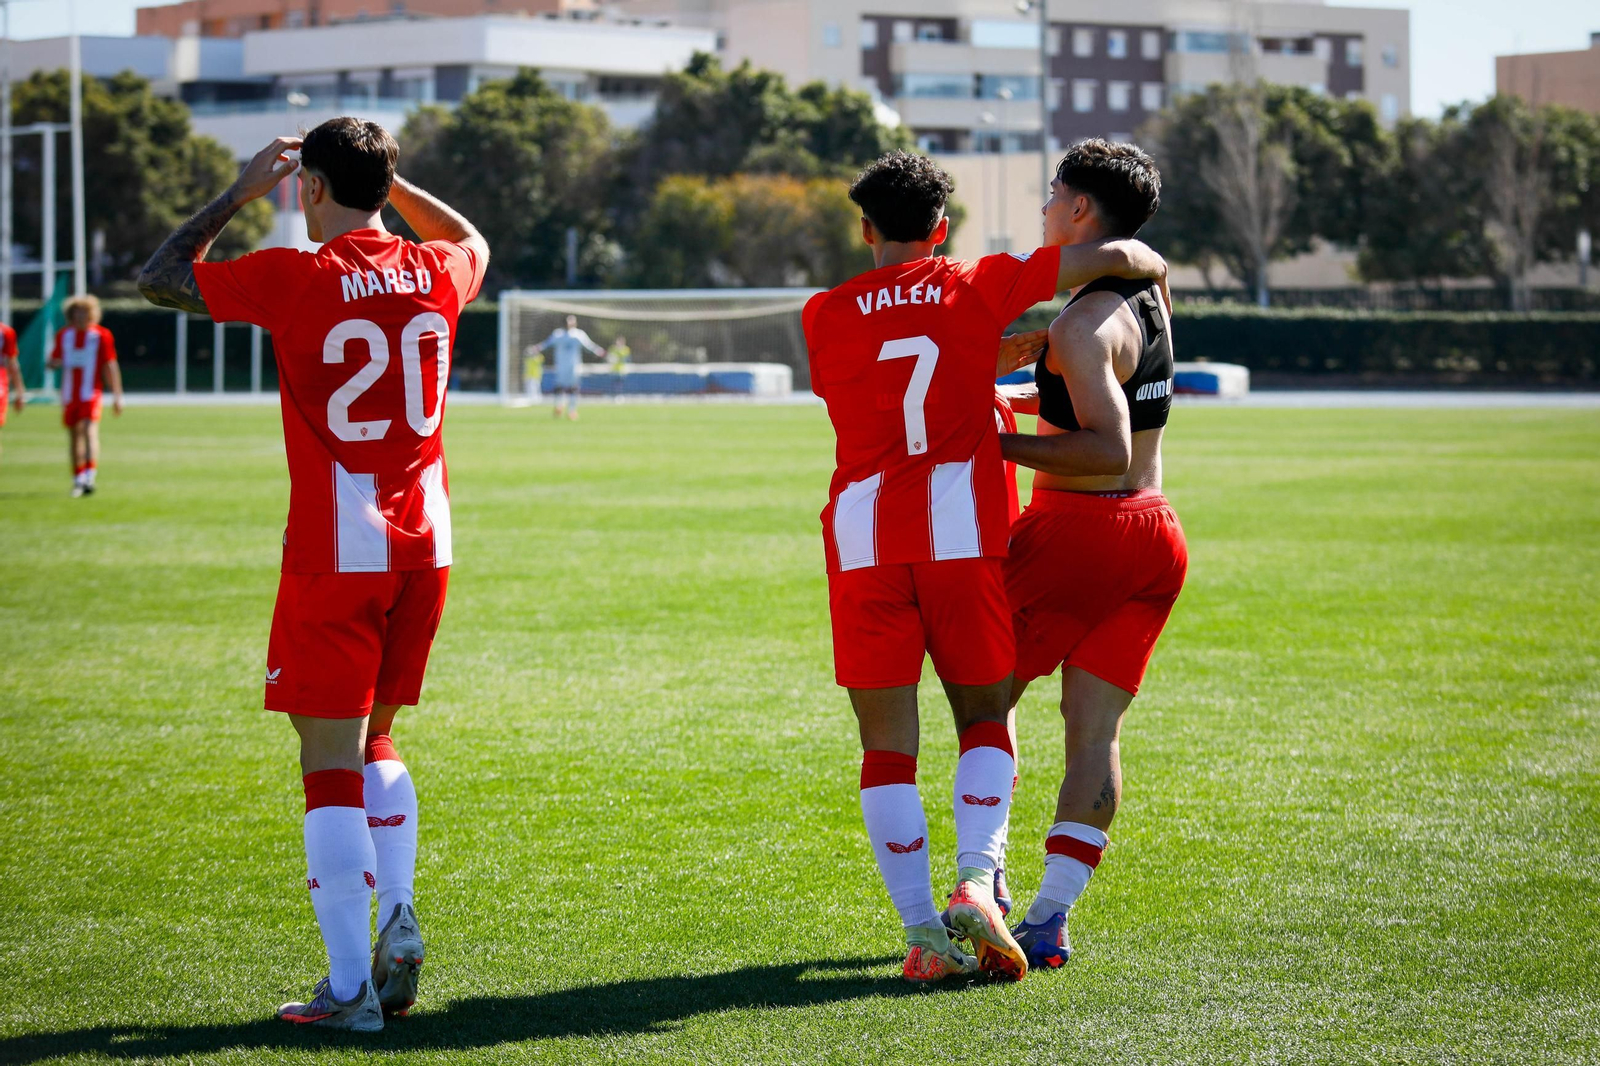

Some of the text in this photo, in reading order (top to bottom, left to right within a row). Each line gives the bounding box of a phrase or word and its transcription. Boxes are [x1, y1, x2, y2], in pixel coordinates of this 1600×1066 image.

[340, 268, 432, 303] MARSU
[856, 283, 942, 316] VALEN
[322, 311, 450, 442] 20
[876, 335, 940, 456] 7
